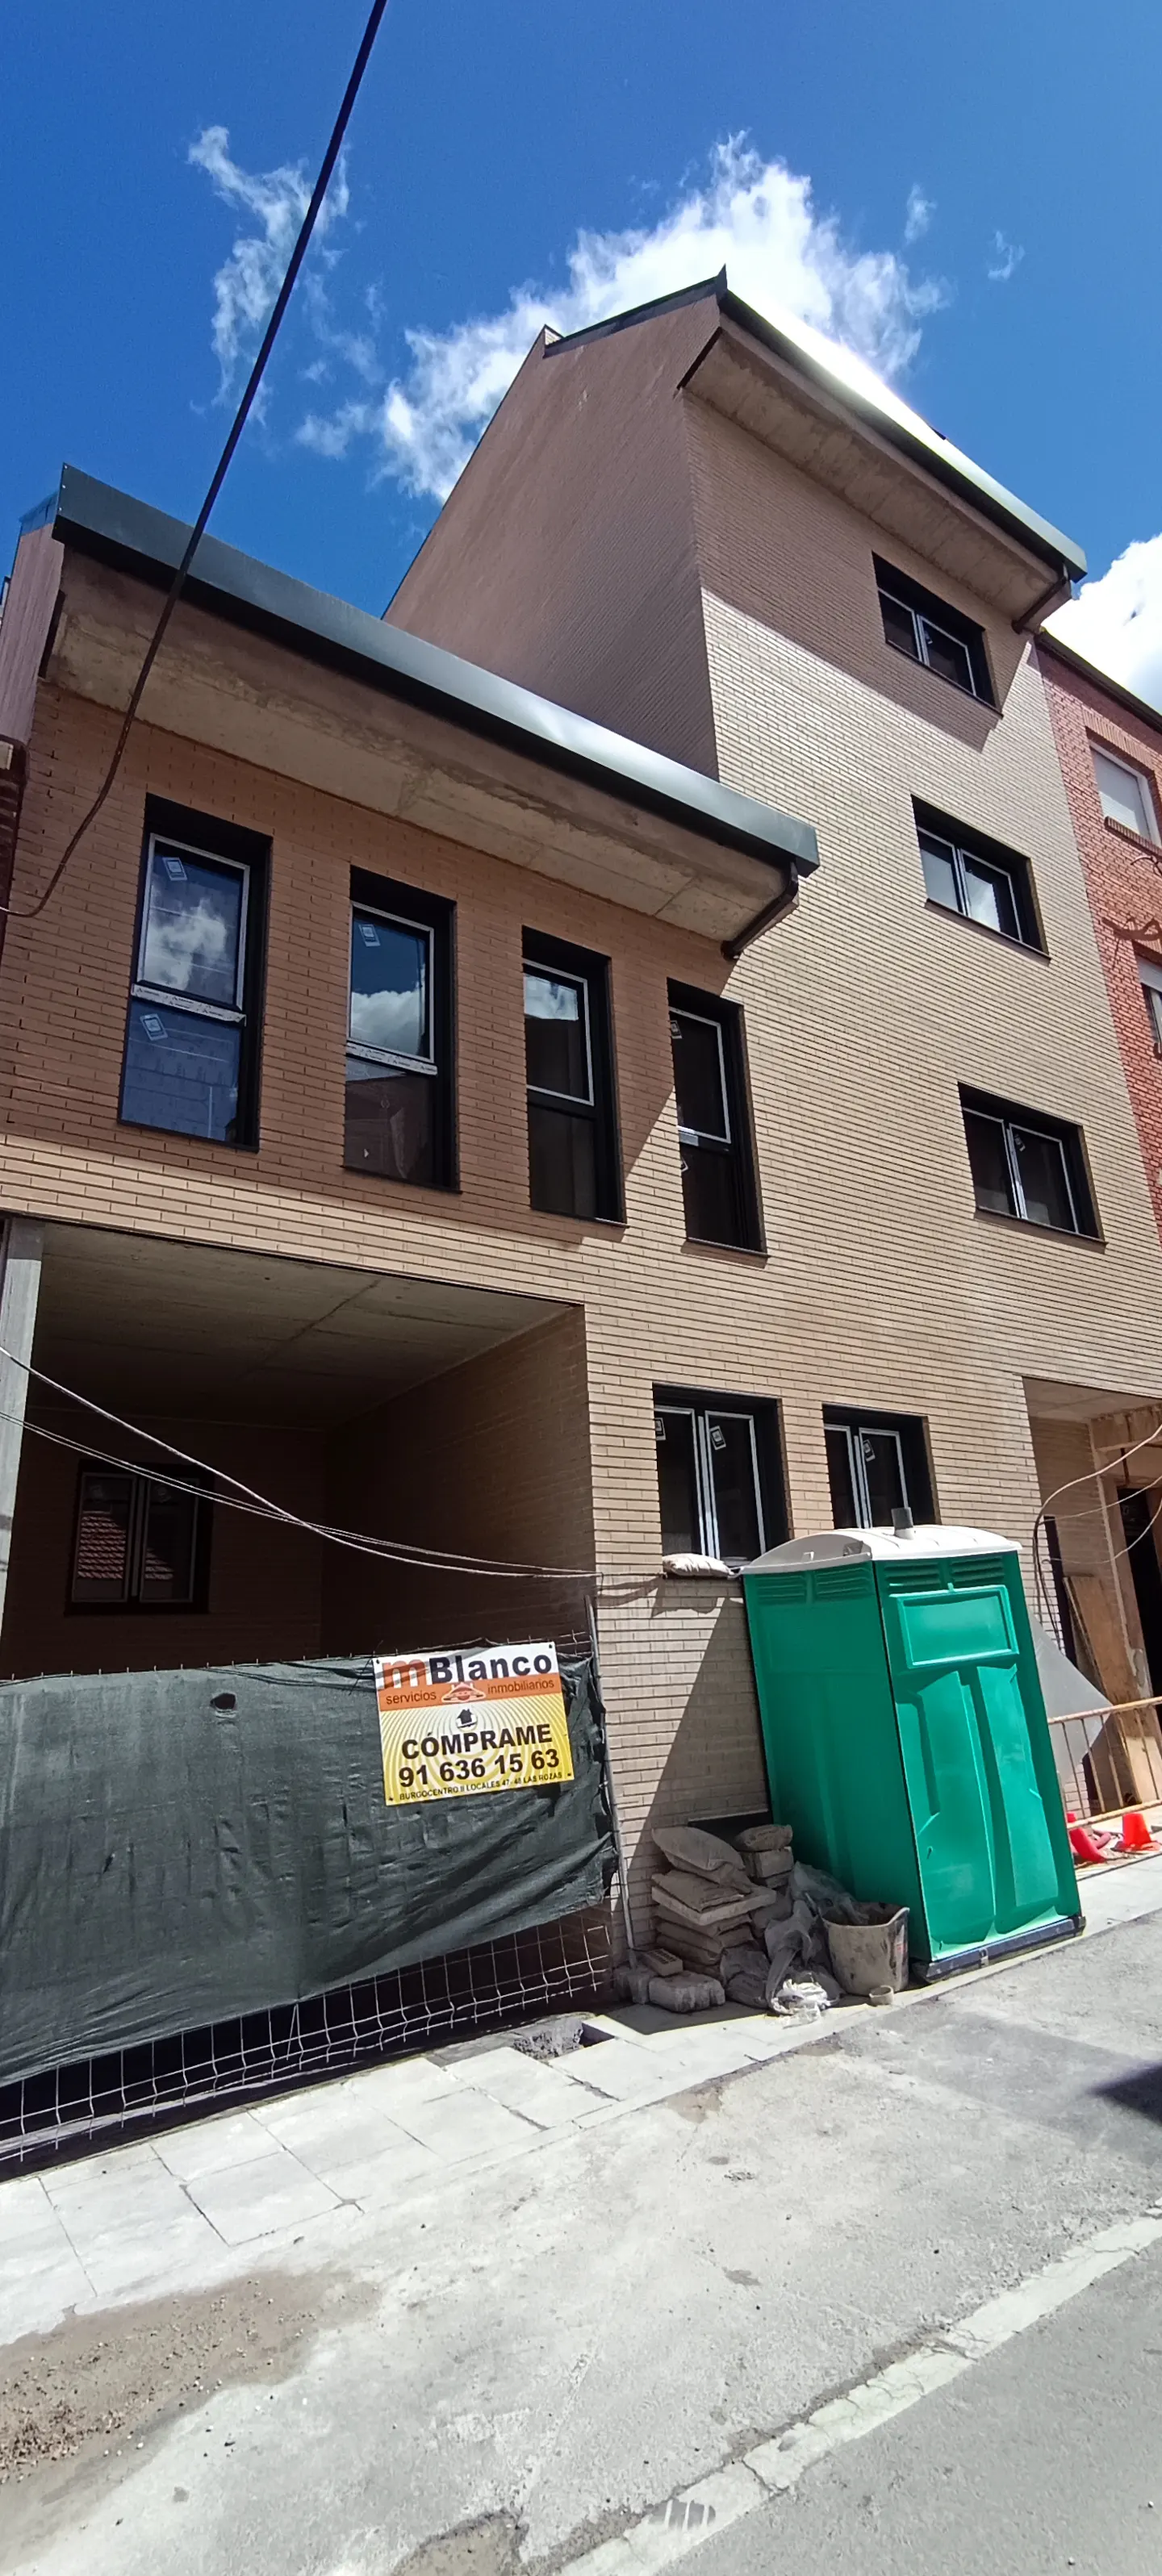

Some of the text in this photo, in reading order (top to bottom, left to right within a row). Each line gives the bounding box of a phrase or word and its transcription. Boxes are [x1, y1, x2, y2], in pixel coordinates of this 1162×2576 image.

[386, 1679, 555, 1705] servicios inmobiliarios
[402, 1724, 553, 1760] CÓMPRAME
[399, 1748, 560, 1788] 91 636 15 63
[399, 1786, 458, 1800] BURGOCENTRO
[466, 1781, 500, 1791] LOCALES
[523, 1775, 537, 1783] LAS
[538, 1772, 562, 1781] ROZAS
